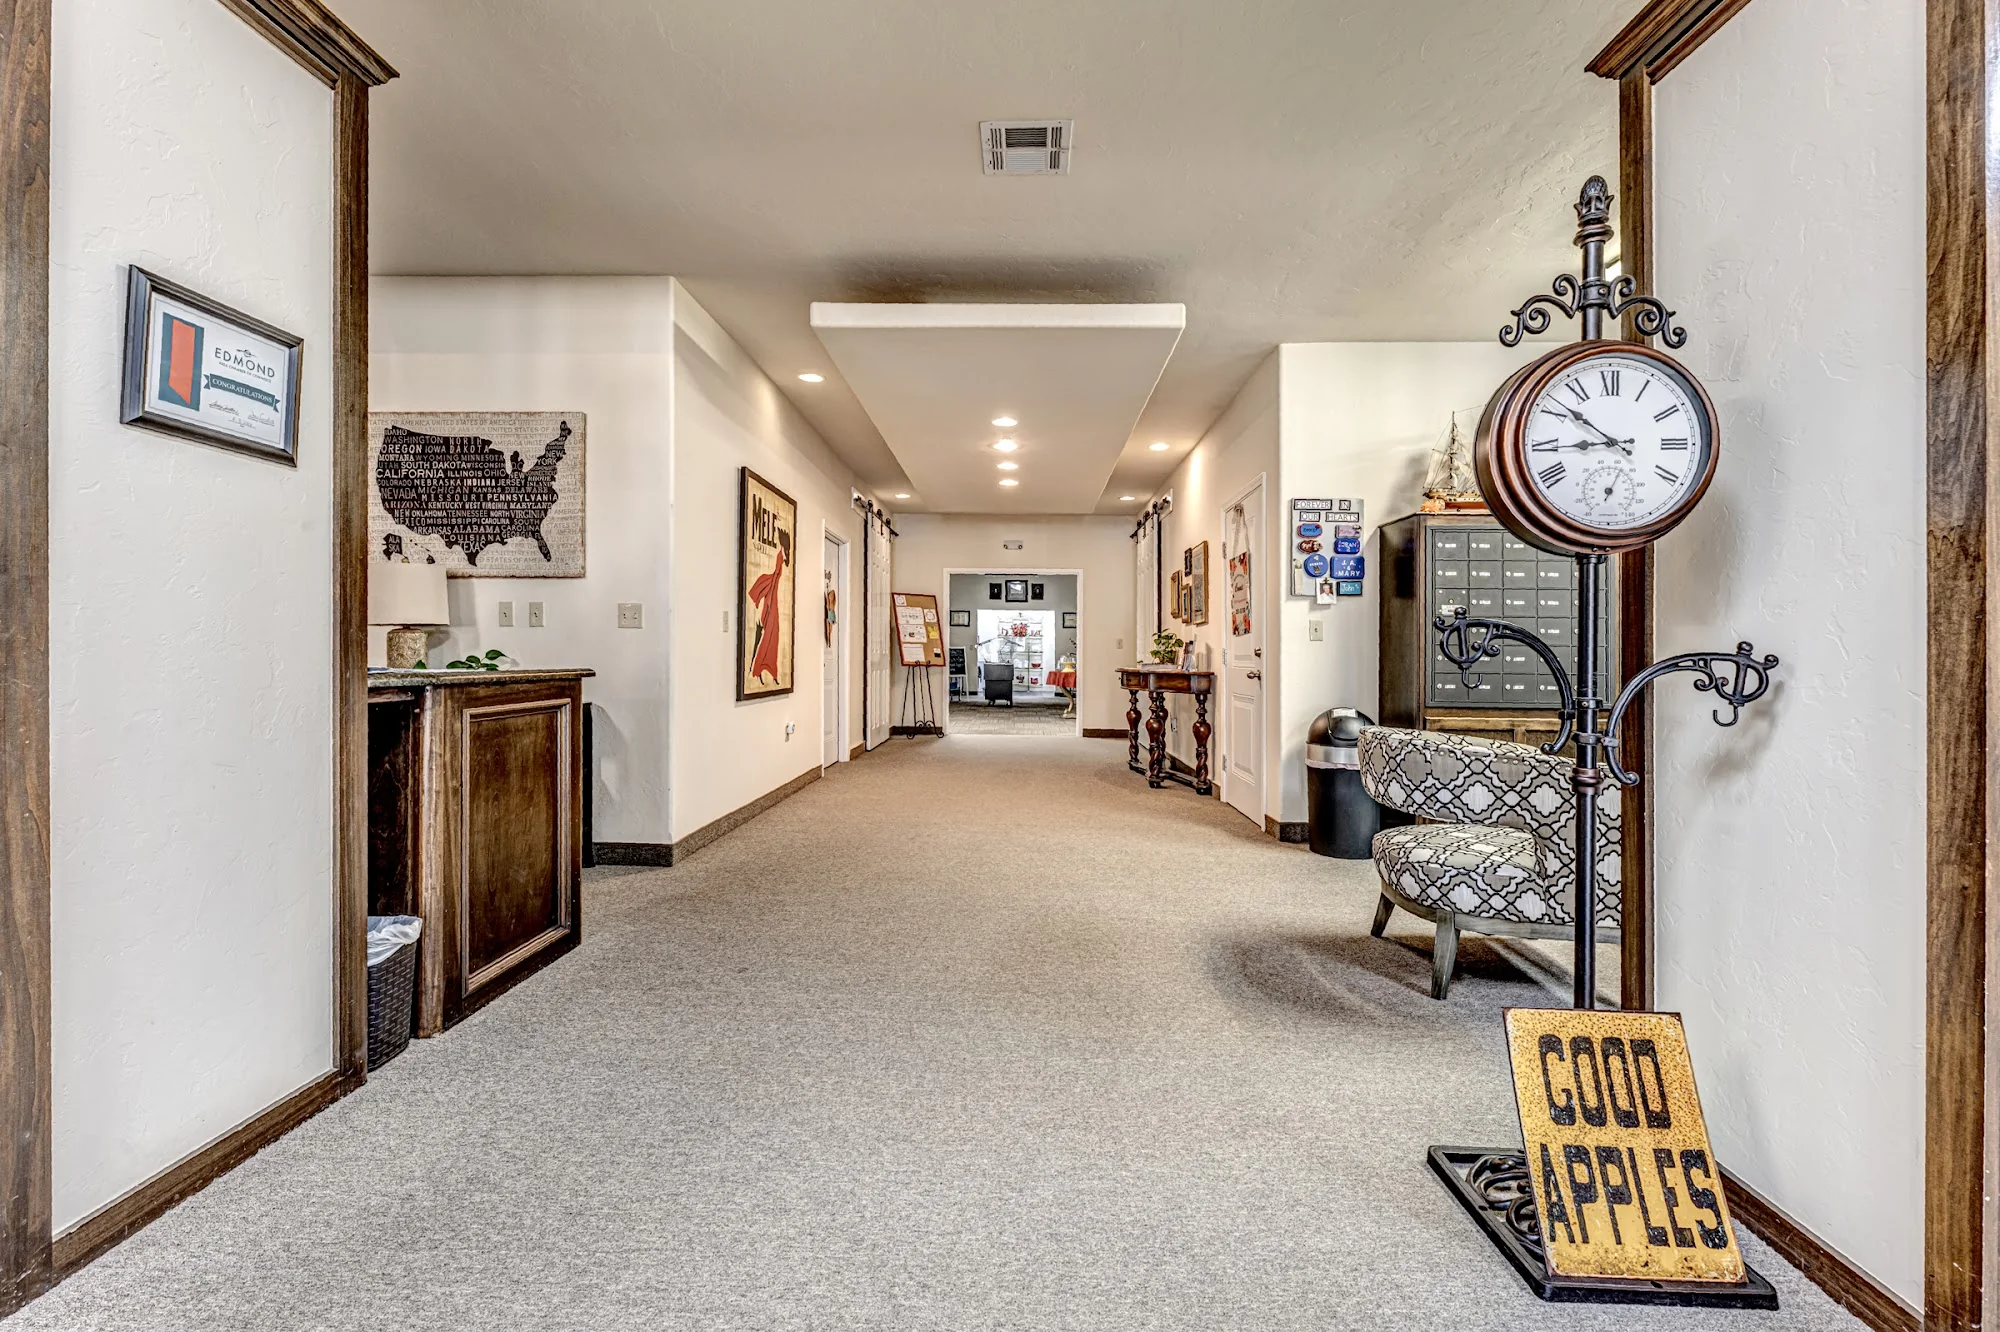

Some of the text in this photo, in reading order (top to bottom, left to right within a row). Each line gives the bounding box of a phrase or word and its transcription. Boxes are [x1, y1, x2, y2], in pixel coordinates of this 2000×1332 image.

[215, 348, 275, 377] EDMOND
[1599, 370, 1621, 397] XII
[212, 378, 273, 403] CONGRATULATIONS
[1565, 377, 1591, 405] XI
[1540, 404, 1568, 423] X
[1654, 404, 1680, 422] II
[384, 436, 482, 445] WASHINGTON NORTH
[1532, 438, 1559, 452] IX
[1660, 438, 1688, 450] III
[381, 445, 490, 454] OREGON IOWA DAKOTA
[379, 454, 415, 462] MONTANA
[537, 457, 558, 466] YORK
[401, 461, 430, 469] SOUTH
[432, 461, 467, 469] DAKOTA
[376, 469, 445, 478] CALIFORNIA
[484, 469, 507, 477] OHIO
[509, 471, 525, 479] NEW
[1538, 461, 1567, 489] VIII
[377, 479, 526, 487] COLORADO NEBRASKA INDIANA JERSEY
[380, 487, 418, 500] NEVADA
[418, 486, 470, 494] MICHIGAN
[421, 493, 559, 502] MISSOURI PENNSYLVANIA
[383, 501, 427, 509] ARIZONA
[428, 501, 464, 509] KENTUCKY
[1295, 501, 1330, 509] FOREVER
[394, 509, 410, 518] NEW
[411, 510, 447, 518] OKLAHOMA
[447, 510, 489, 518] TENNESSEE
[490, 510, 510, 518] NORTH
[510, 509, 546, 519] VIRGINIA
[1327, 513, 1358, 521] HEARTS
[394, 517, 426, 526] MEXICO
[514, 518, 540, 526] SOUTH
[752, 493, 777, 549] MELE
[413, 526, 452, 535] ARKANSAS
[452, 525, 501, 534] ALABAMA
[388, 535, 400, 544] ALA
[443, 534, 502, 542] LOUISIANA
[501, 531, 533, 539] GEORGIA
[388, 544, 400, 553] SKA
[457, 540, 486, 553] TEXAS
[1538, 1033, 1672, 1129] GOOD
[1540, 1143, 1729, 1250] APPLES
